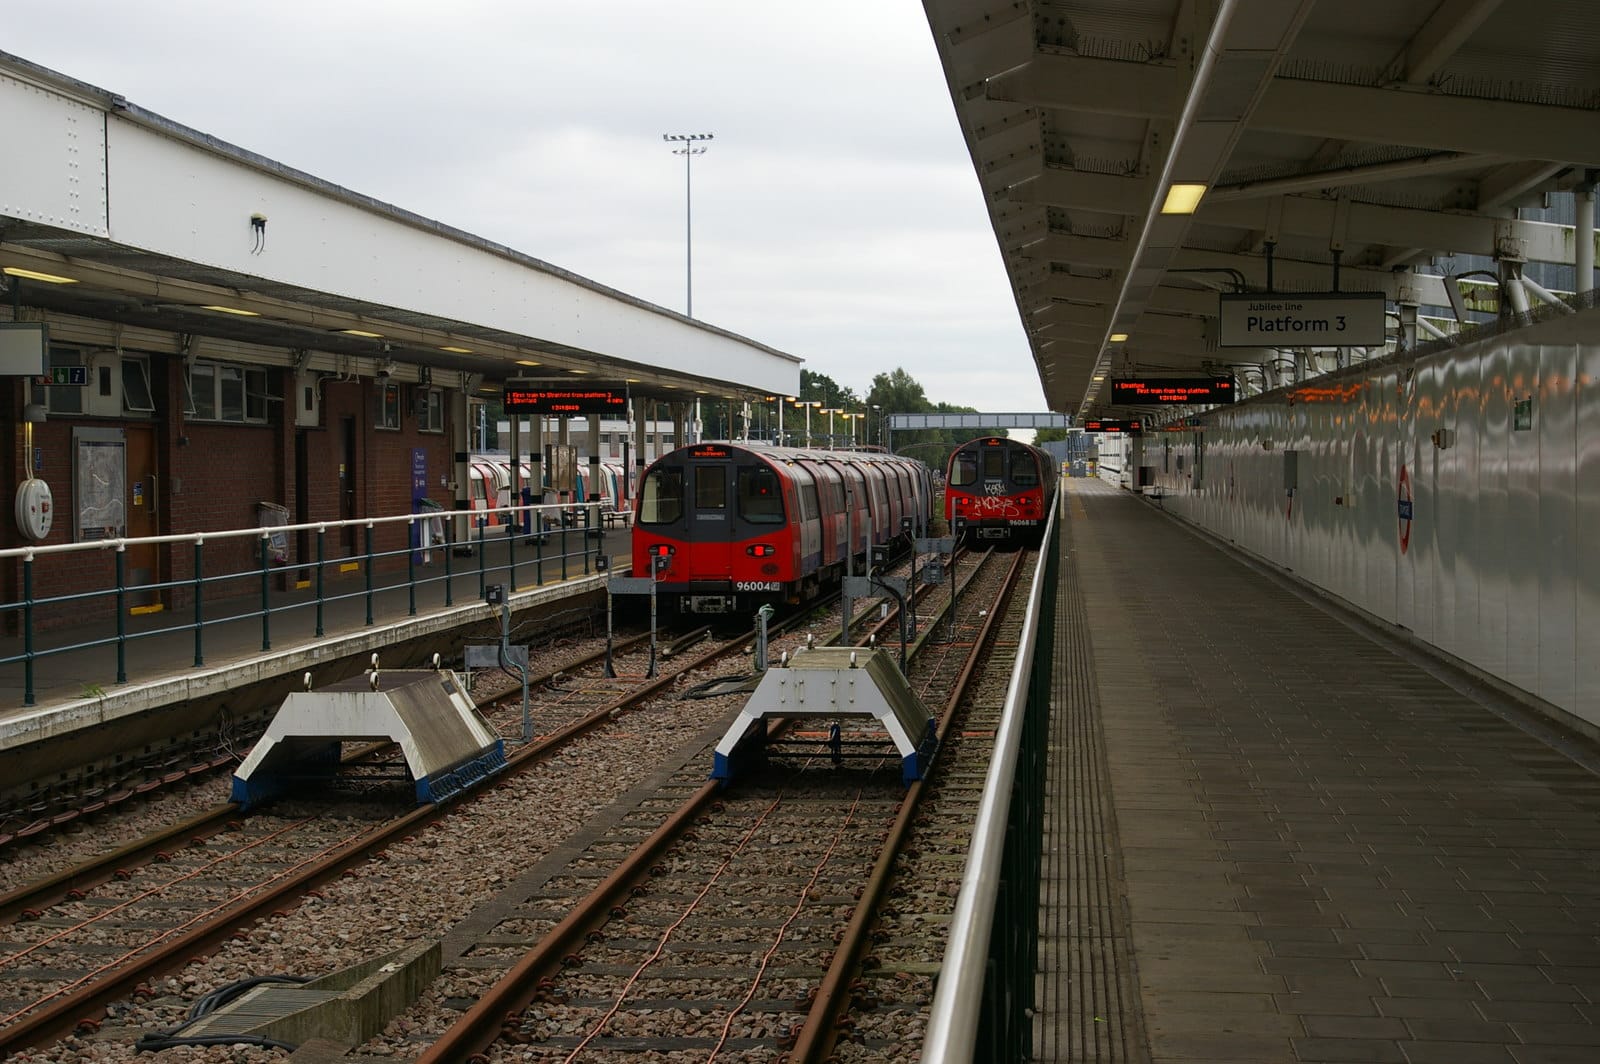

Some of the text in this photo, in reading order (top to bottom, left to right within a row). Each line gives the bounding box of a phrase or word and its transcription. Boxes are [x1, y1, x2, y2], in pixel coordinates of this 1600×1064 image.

[1248, 303, 1303, 311] Jubilee line
[1247, 316, 1346, 332] Platform 3
[736, 581, 770, 591] 96004
